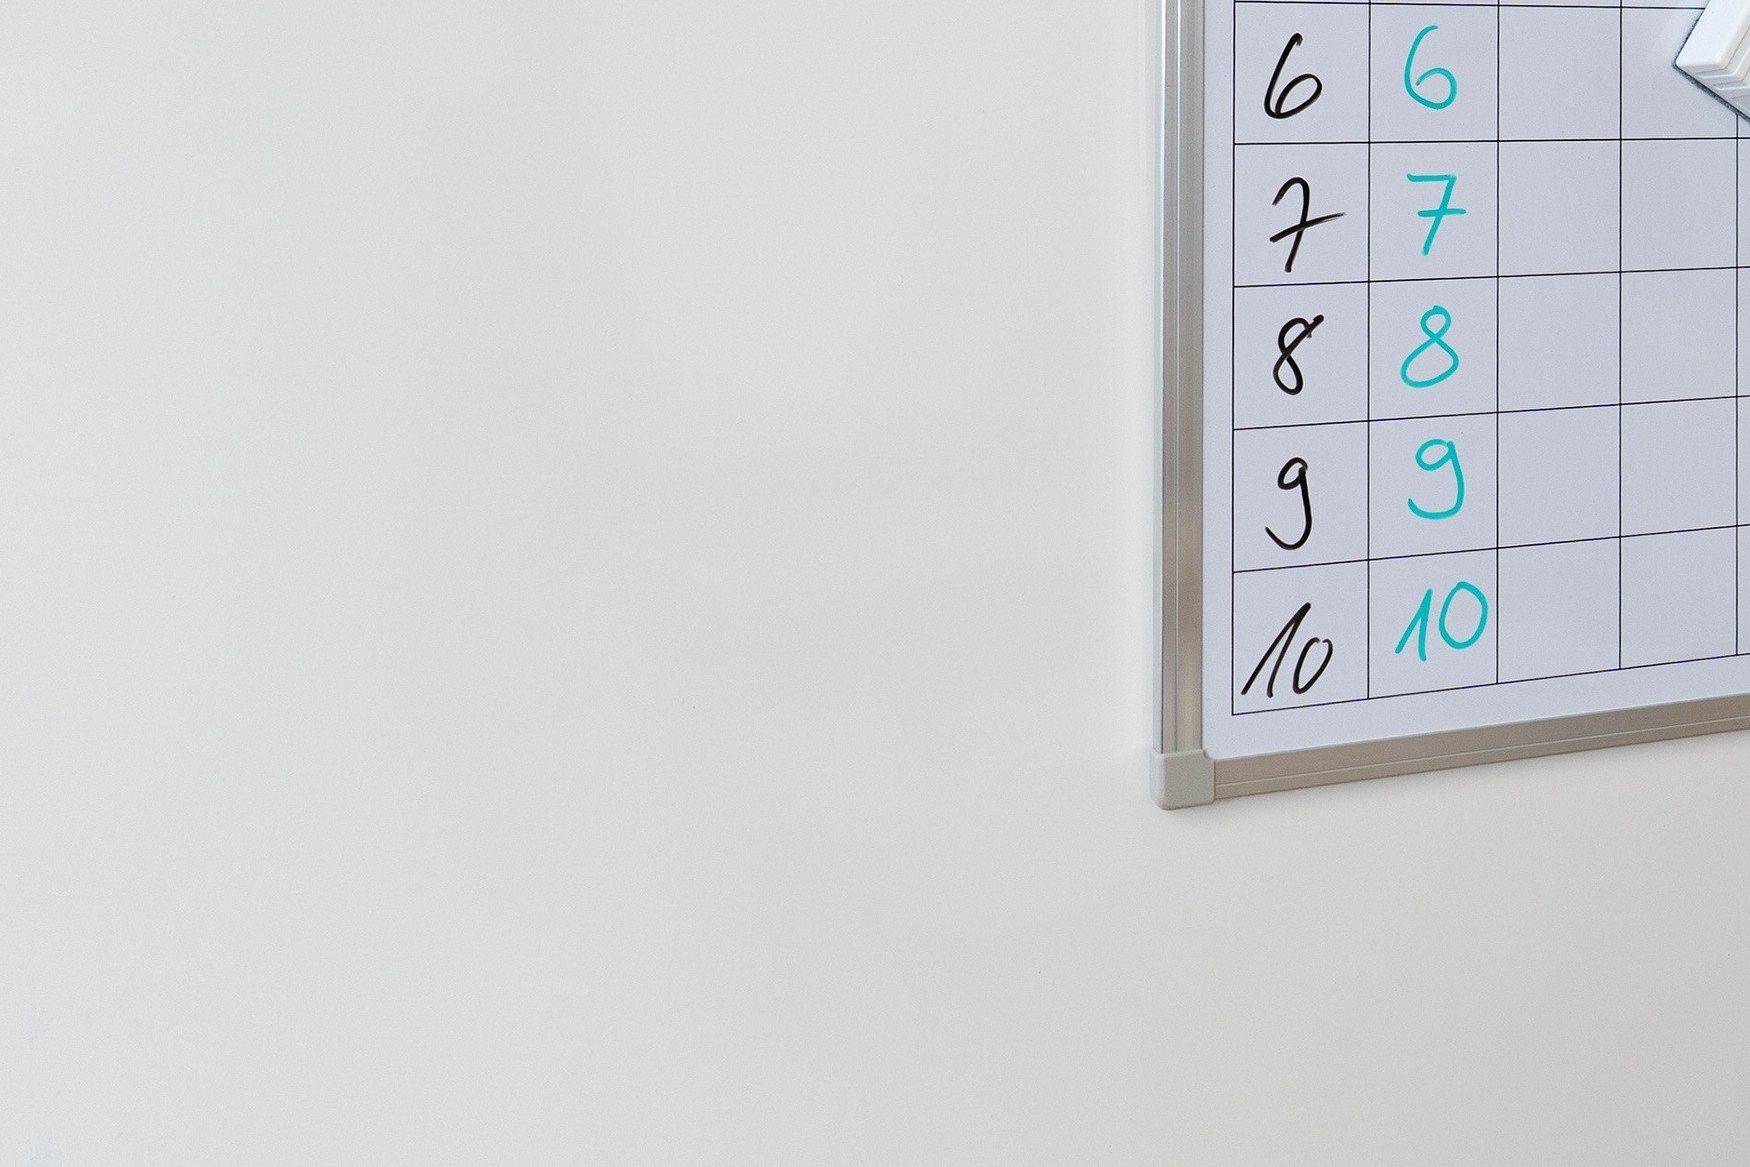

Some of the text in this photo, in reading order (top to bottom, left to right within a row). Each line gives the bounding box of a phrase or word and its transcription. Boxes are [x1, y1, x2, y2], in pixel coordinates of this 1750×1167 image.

[1264, 33, 1323, 120] 6
[1404, 25, 1458, 110] 6
[1269, 176, 1347, 272] 7
[1406, 173, 1467, 255] 7
[1272, 314, 1324, 395] 8
[1400, 304, 1460, 388] 8
[1264, 457, 1313, 550] 9
[1407, 438, 1466, 519] 9
[1241, 602, 1334, 698] 10
[1394, 581, 1489, 661] 10
